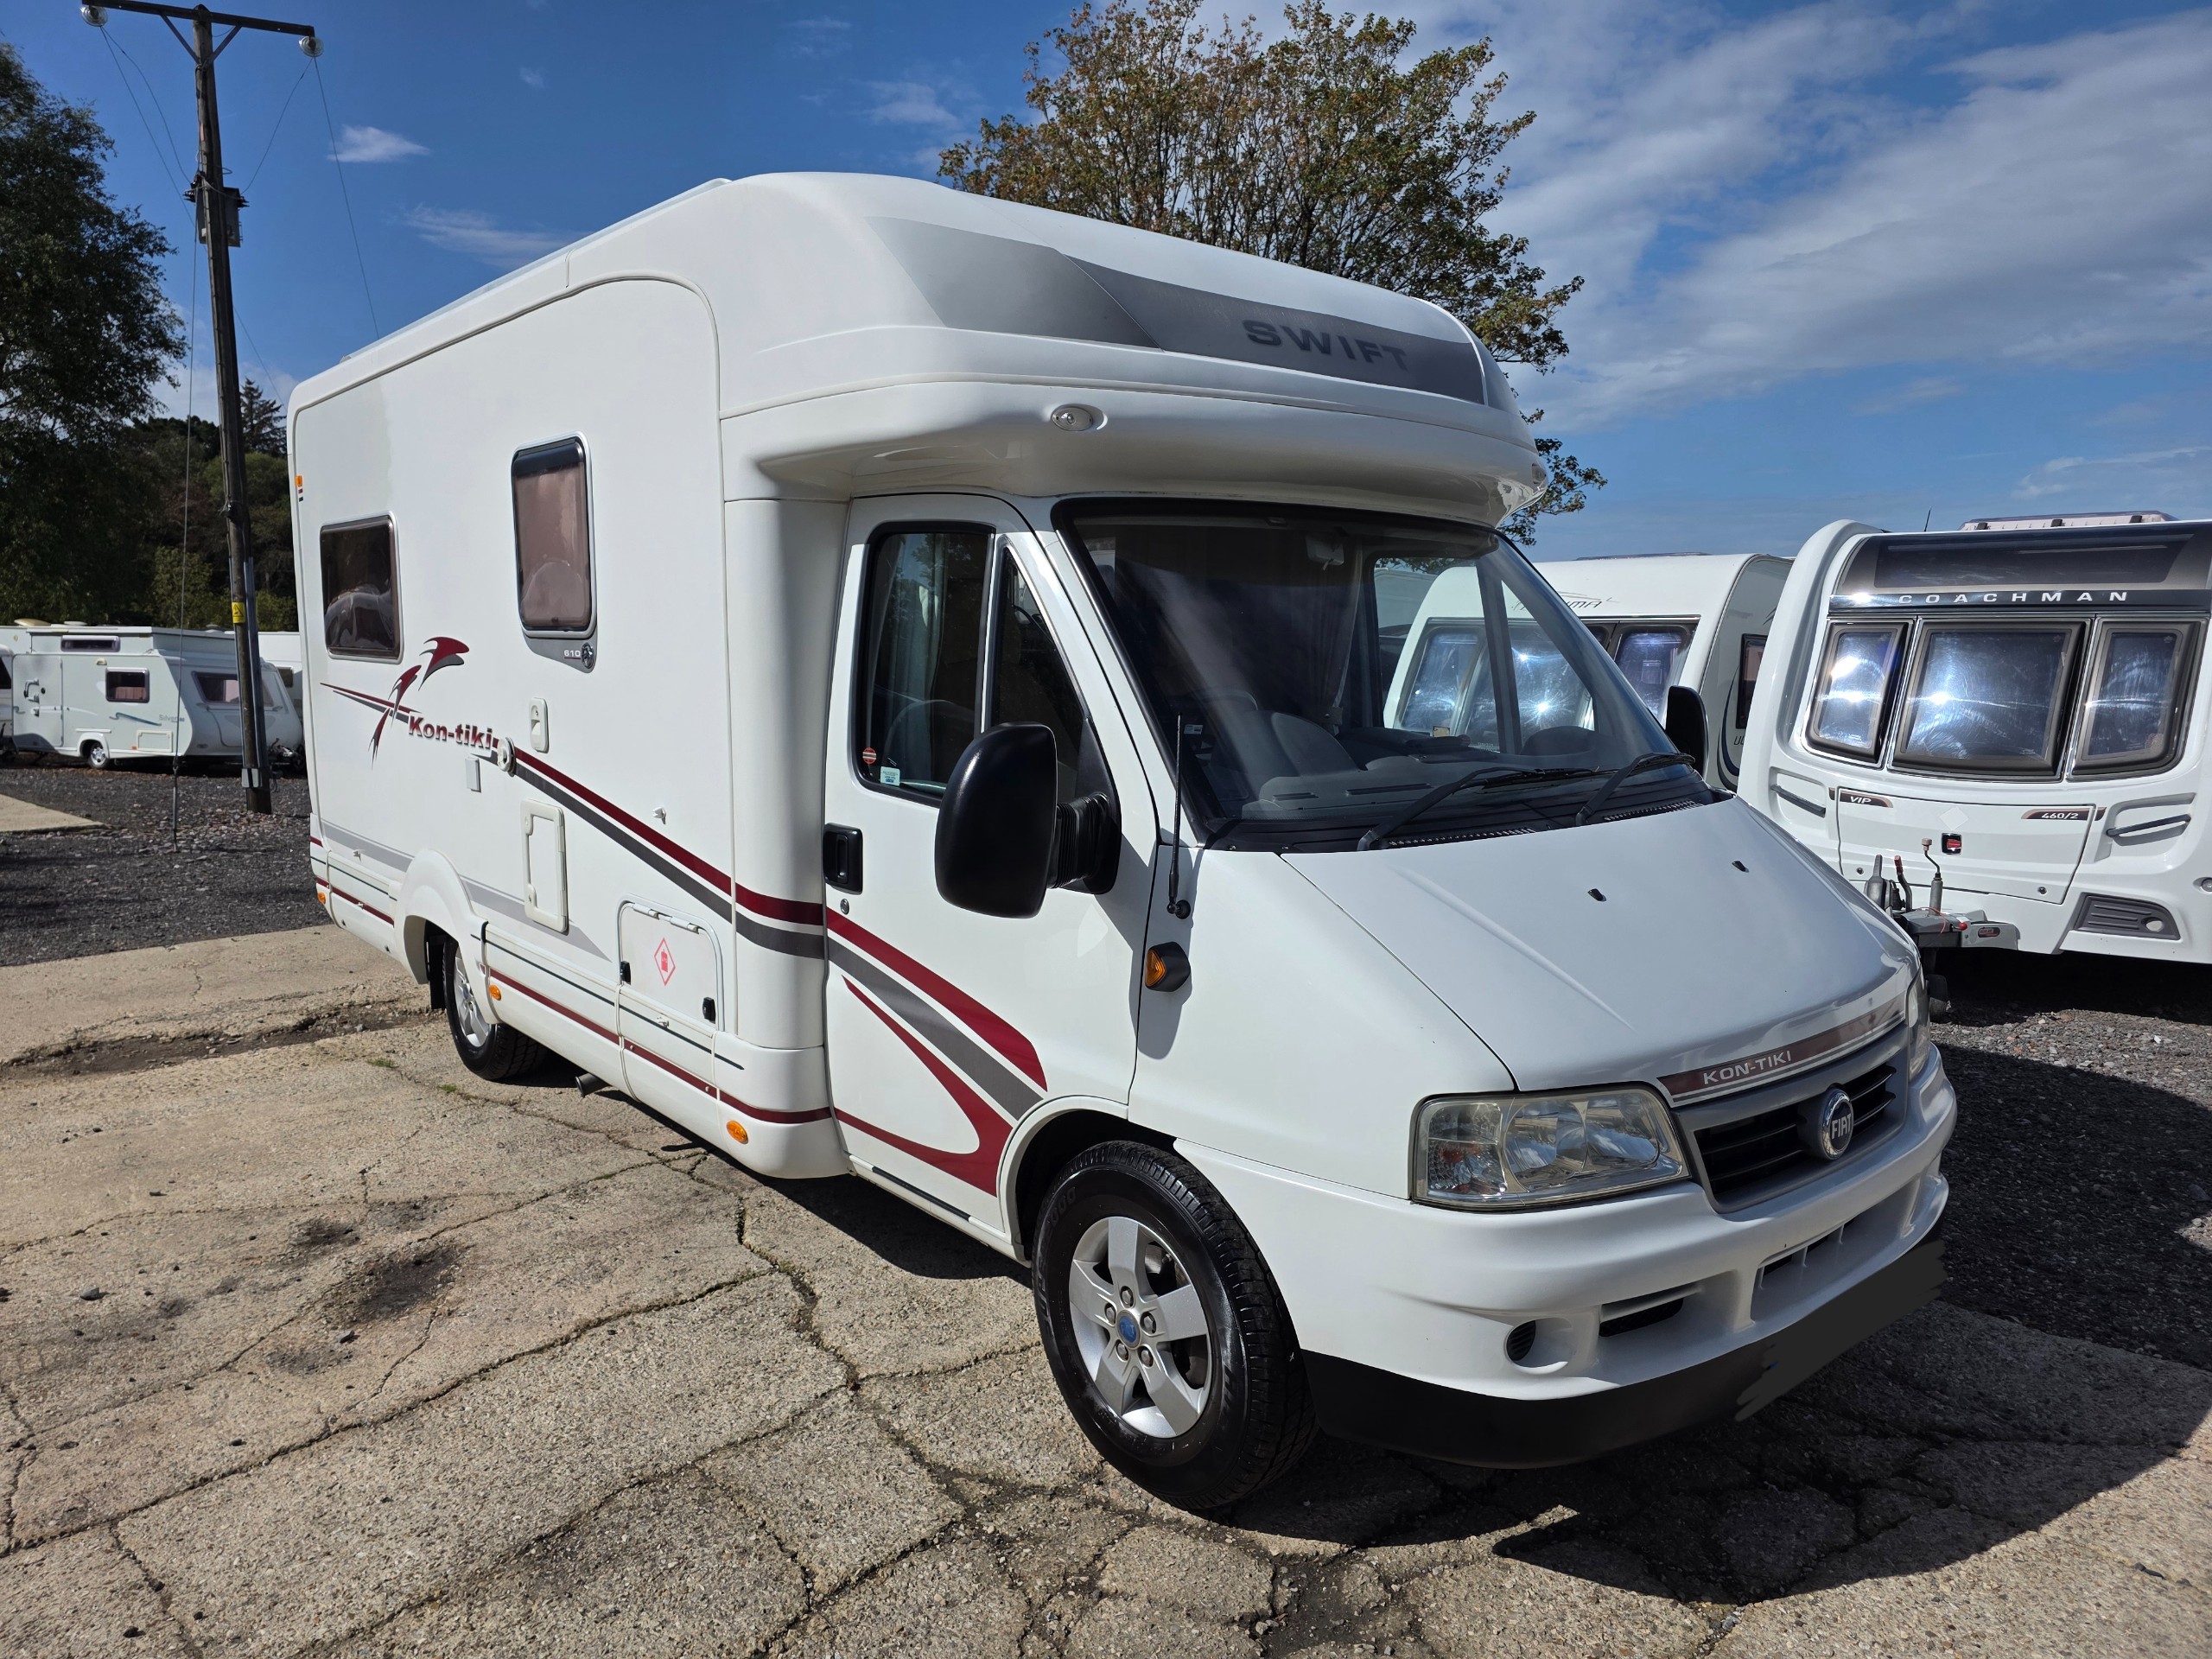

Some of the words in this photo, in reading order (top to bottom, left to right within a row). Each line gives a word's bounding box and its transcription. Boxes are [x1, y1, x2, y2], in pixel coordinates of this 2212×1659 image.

[1242, 319, 1408, 372] SWIFT
[1898, 591, 2128, 604] COACHMAN
[408, 715, 493, 749] Kon-tiki
[1849, 795, 1872, 804] VIP
[2040, 810, 2080, 821] 460/2
[1703, 1049, 1791, 1085] KON-TIKI
[1830, 1113, 1853, 1141] FIAT
